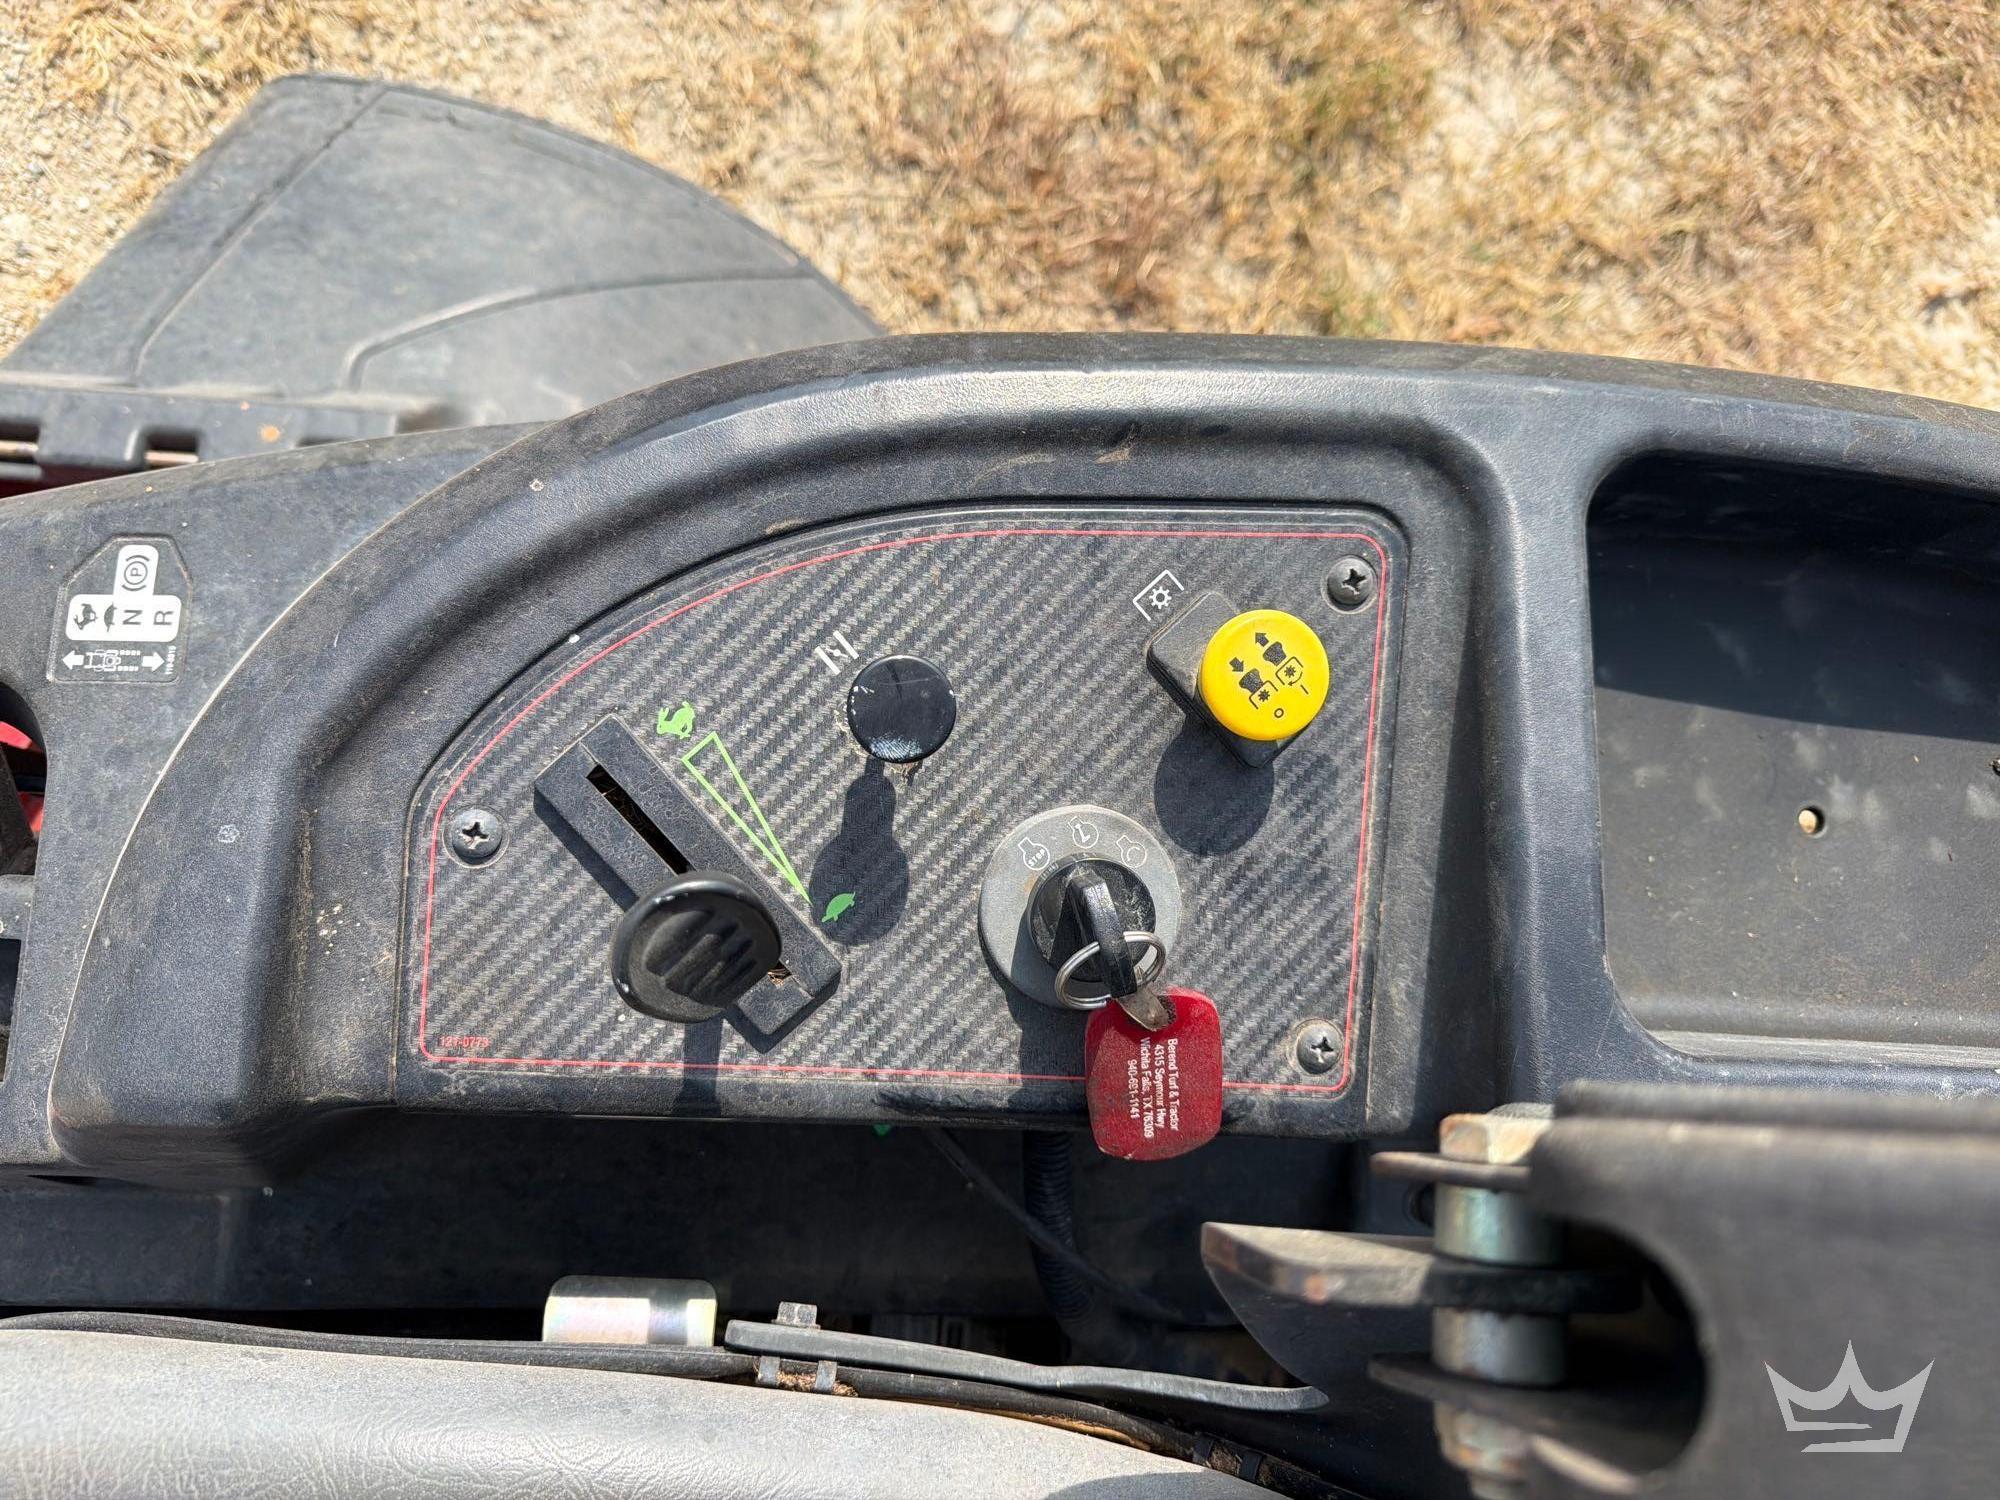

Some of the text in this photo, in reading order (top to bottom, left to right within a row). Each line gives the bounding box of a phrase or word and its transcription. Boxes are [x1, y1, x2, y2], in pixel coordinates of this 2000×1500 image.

[122, 609, 174, 625] N R
[1028, 848, 1046, 867] STOP
[1140, 1037, 1154, 1138] Wichita Falls, TX 76309
[1153, 1044, 1166, 1129] 4315 Seymour Hwy
[1167, 1038, 1180, 1131] Berend Turf & Tractor
